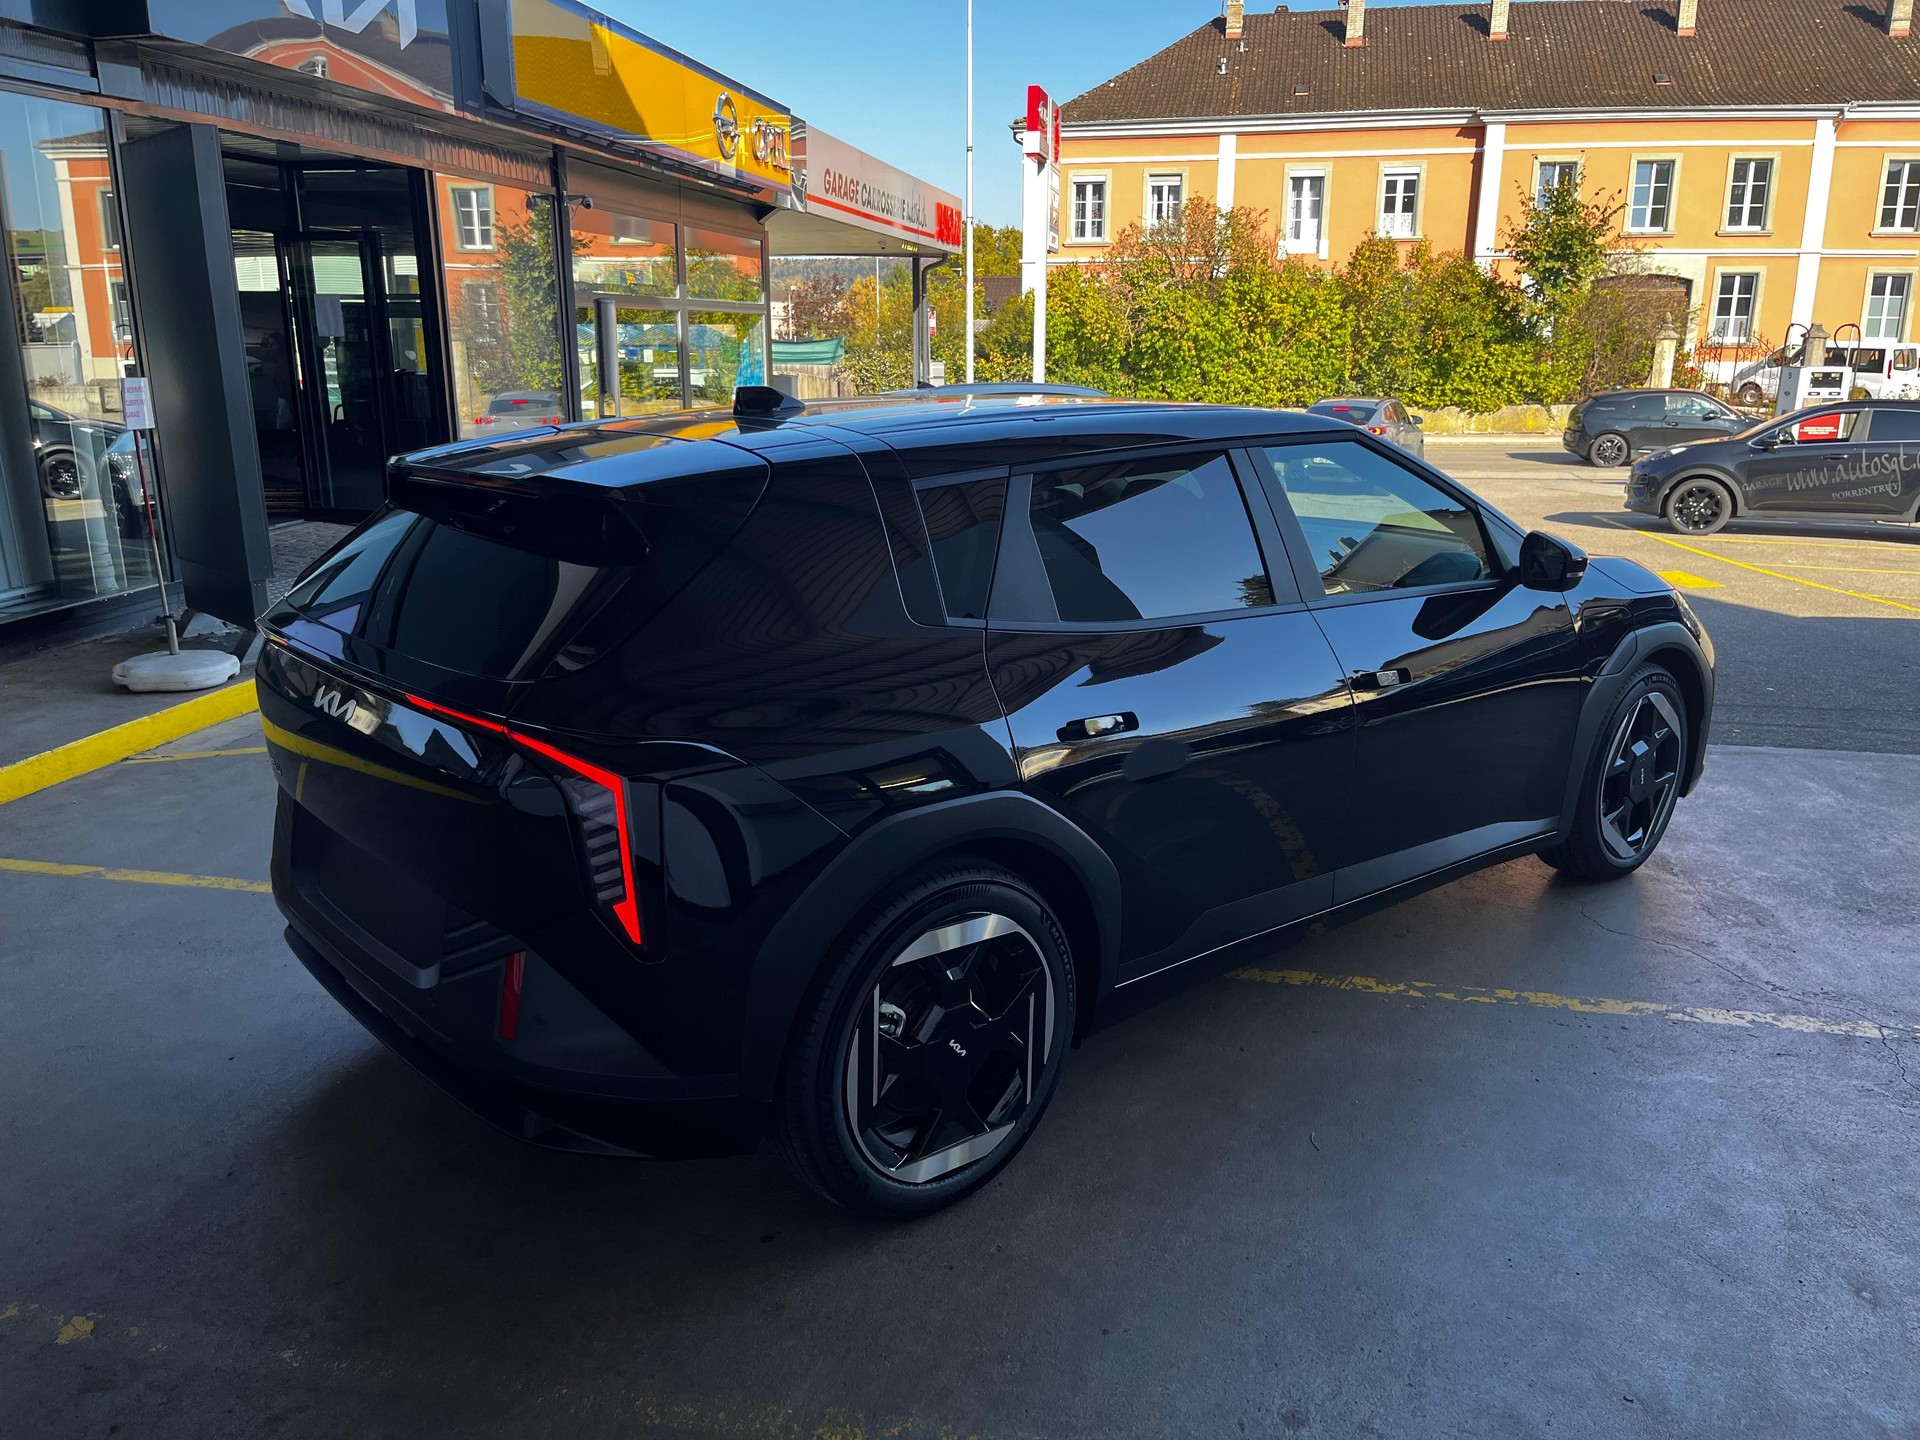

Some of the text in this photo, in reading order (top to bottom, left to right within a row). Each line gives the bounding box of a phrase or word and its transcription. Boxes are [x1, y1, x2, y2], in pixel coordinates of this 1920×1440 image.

[823, 167, 860, 205] GARAGE
[1741, 477, 1782, 491] GARAGE
[1831, 482, 1899, 500] PORRENTRUY
[313, 684, 357, 722] KIA
[949, 1039, 967, 1056] KIA
